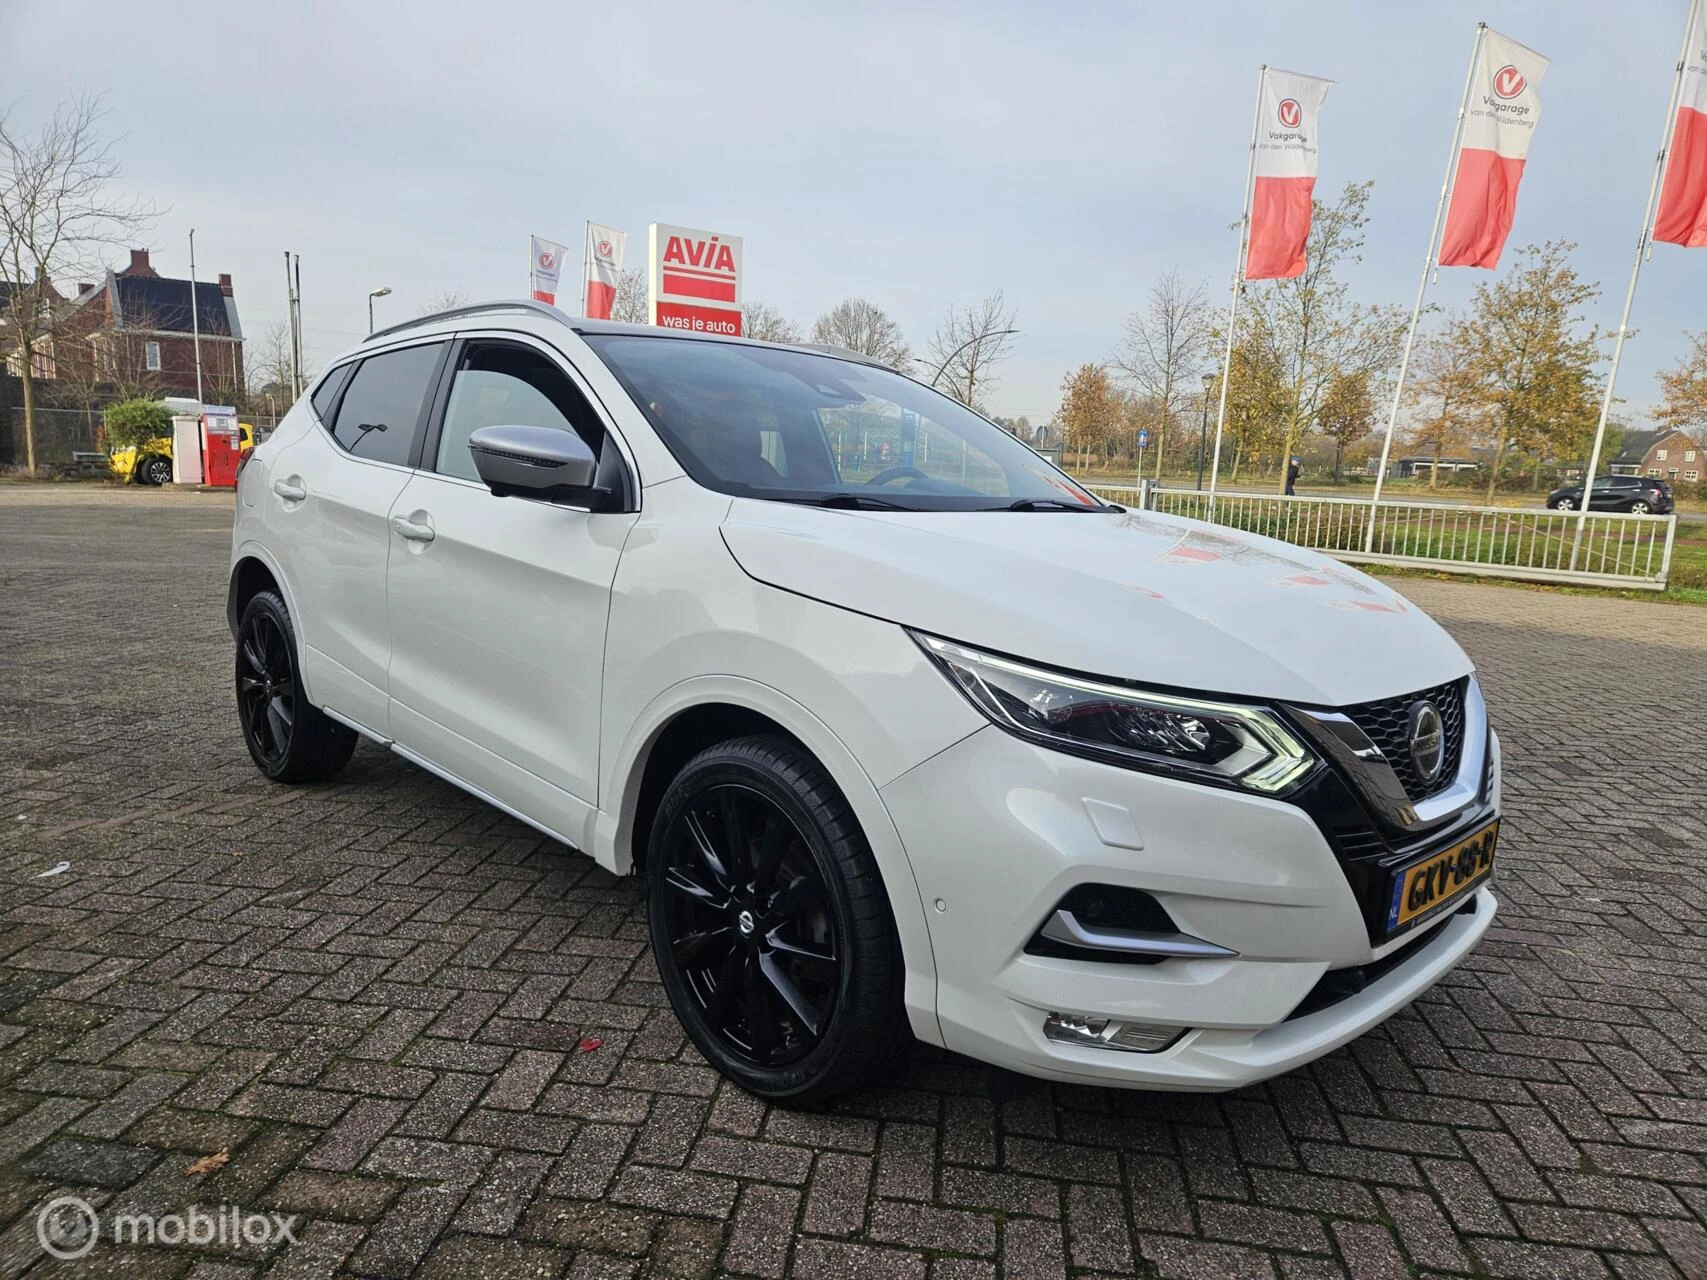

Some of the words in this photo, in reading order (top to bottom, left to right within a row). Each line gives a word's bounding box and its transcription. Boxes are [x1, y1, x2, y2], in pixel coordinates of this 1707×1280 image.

[1483, 96, 1530, 116] Vagarage
[662, 315, 689, 328] was
[692, 316, 704, 331] je
[706, 320, 736, 333] auto
[1389, 906, 1398, 920] NL
